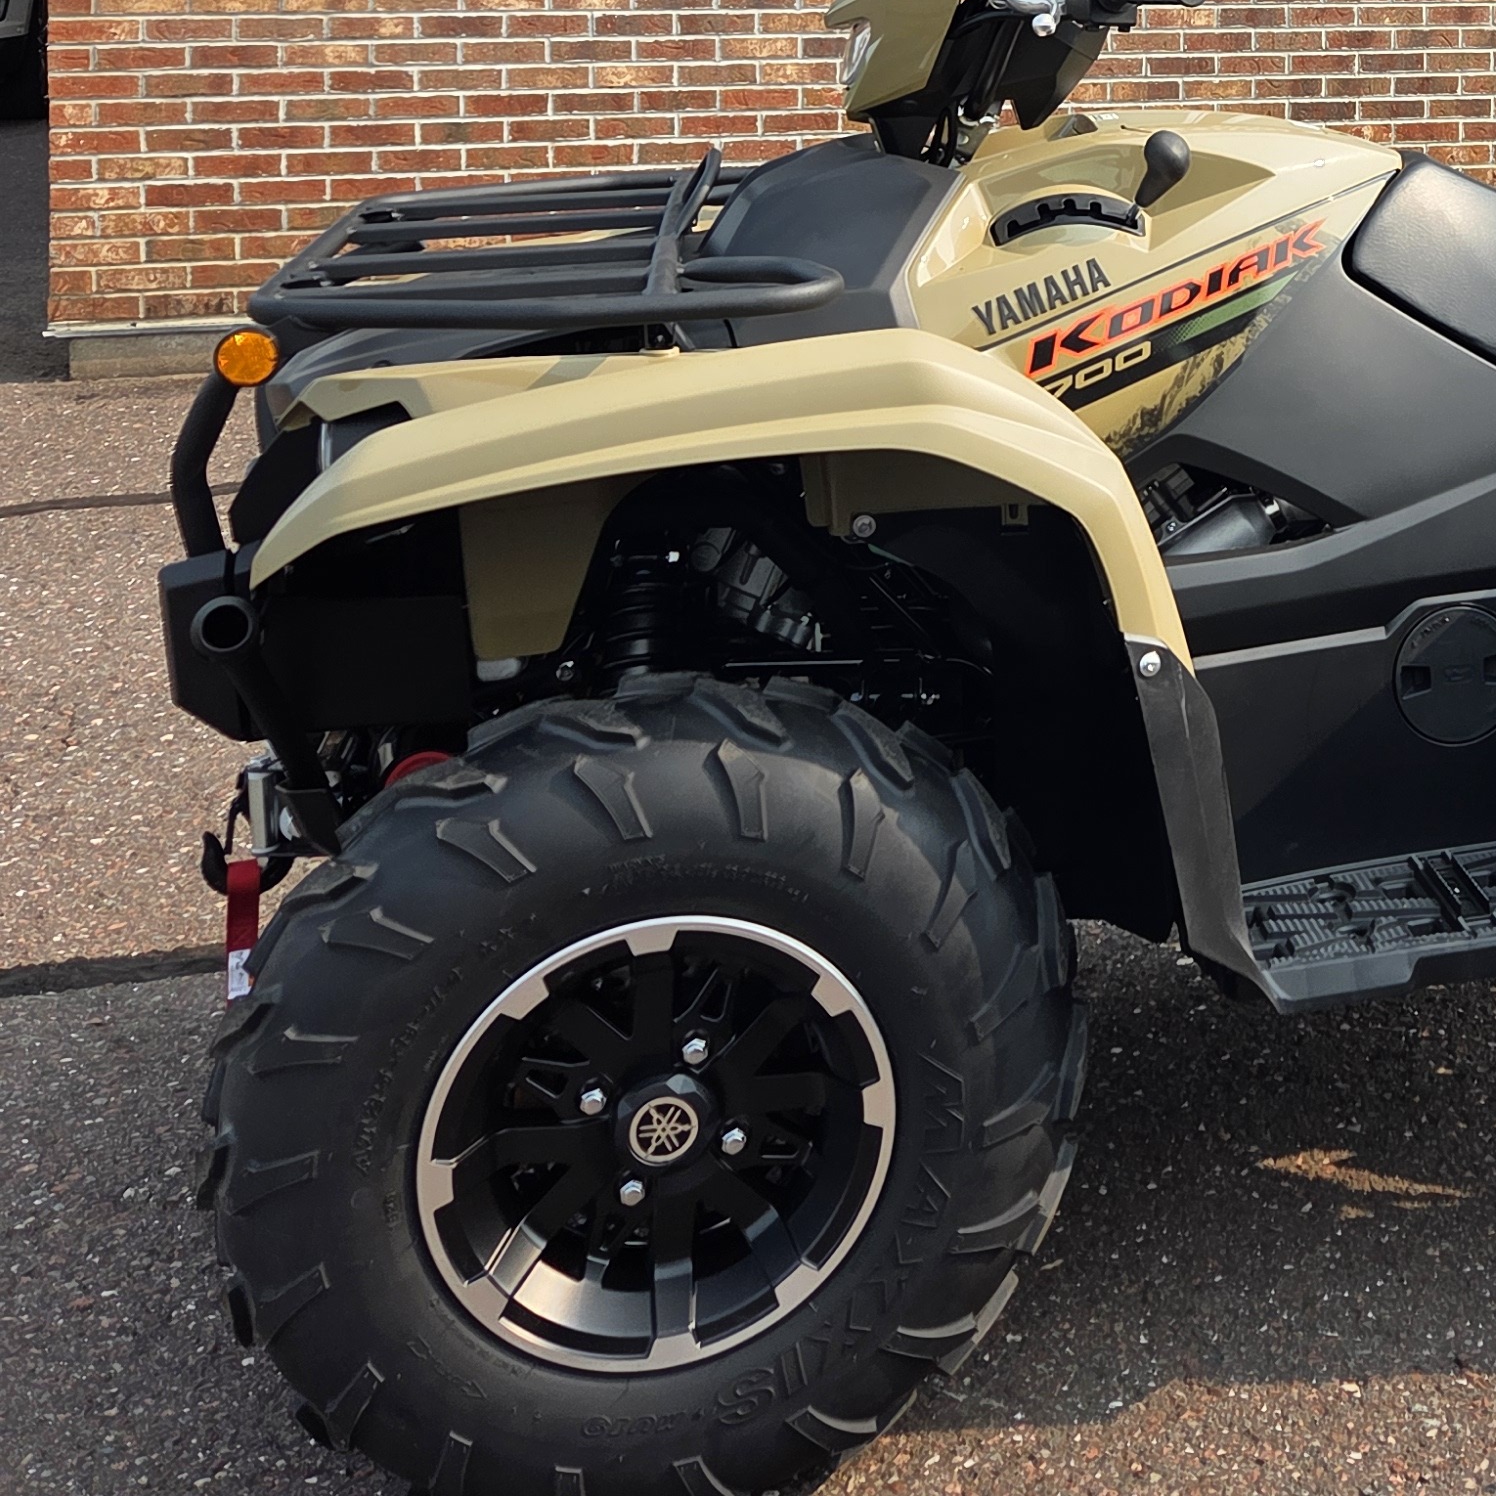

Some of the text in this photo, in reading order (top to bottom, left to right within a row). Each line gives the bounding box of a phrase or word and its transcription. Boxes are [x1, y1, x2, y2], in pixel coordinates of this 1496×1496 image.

[972, 257, 1112, 336] YAMAHA
[1025, 218, 1326, 376] KODIAK
[1043, 340, 1152, 399] 700
